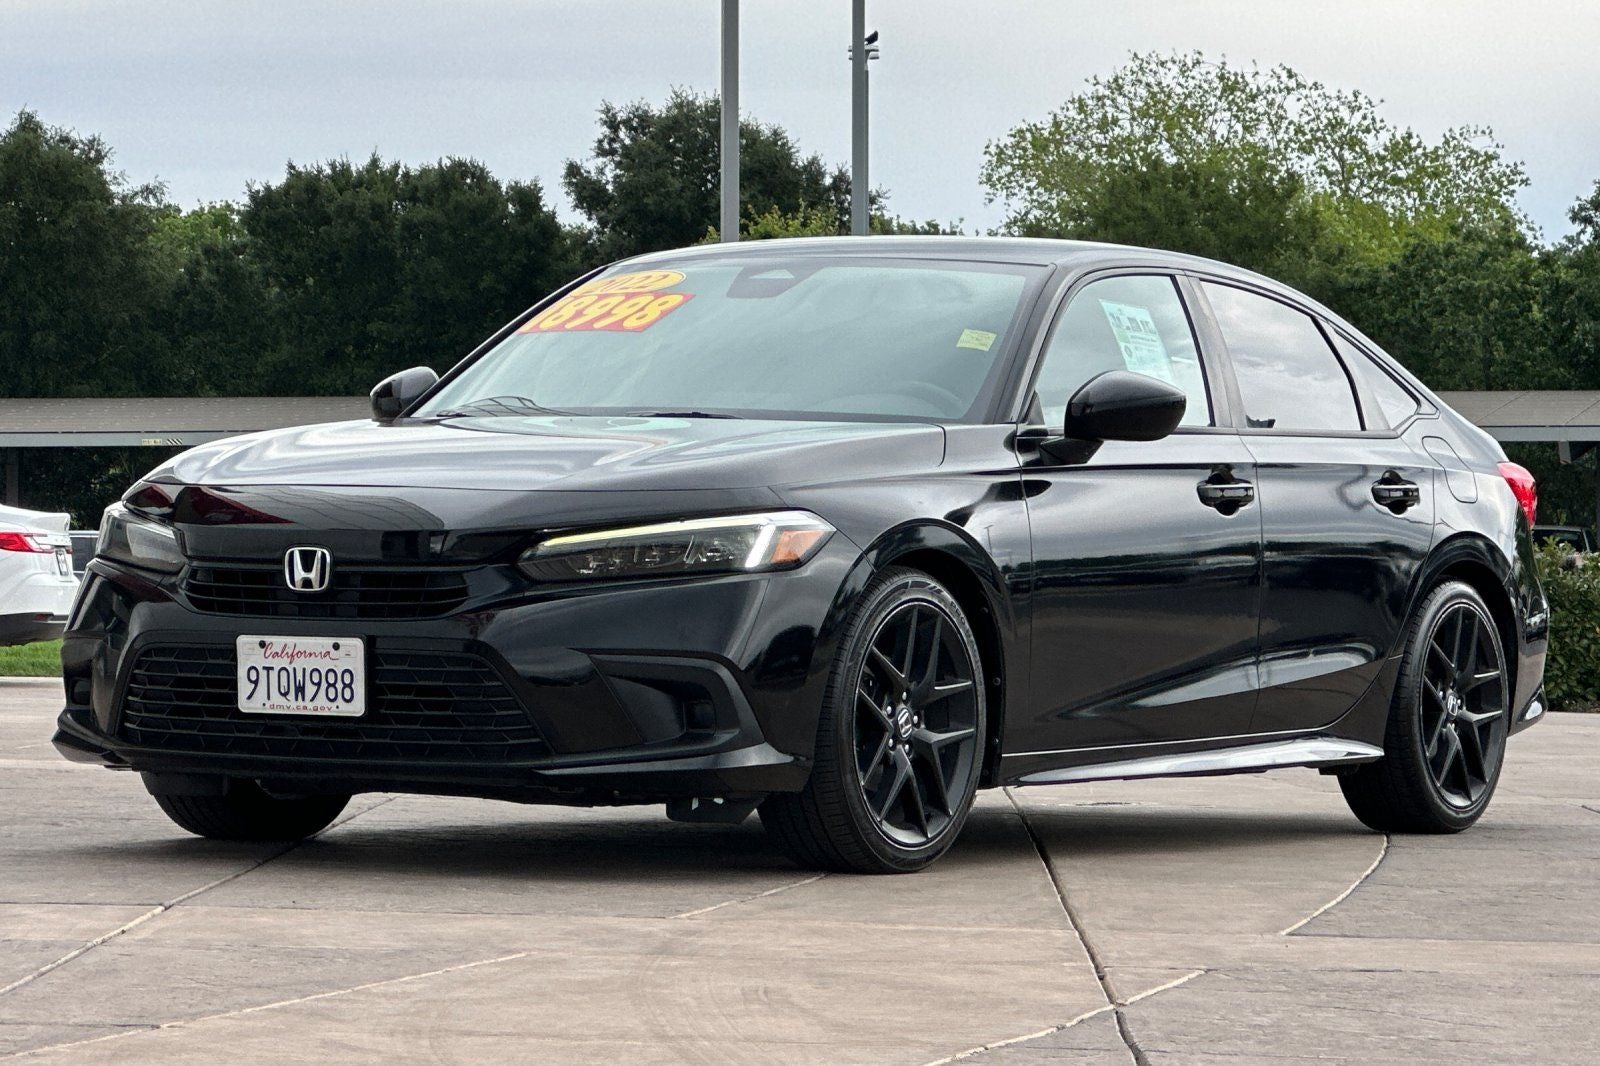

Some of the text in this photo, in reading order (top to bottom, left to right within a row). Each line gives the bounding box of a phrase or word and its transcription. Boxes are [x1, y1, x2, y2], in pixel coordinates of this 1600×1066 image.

[263, 642, 339, 665] California
[246, 666, 354, 703] 9TQW988
[269, 703, 333, 712] dmv.ca.gov
